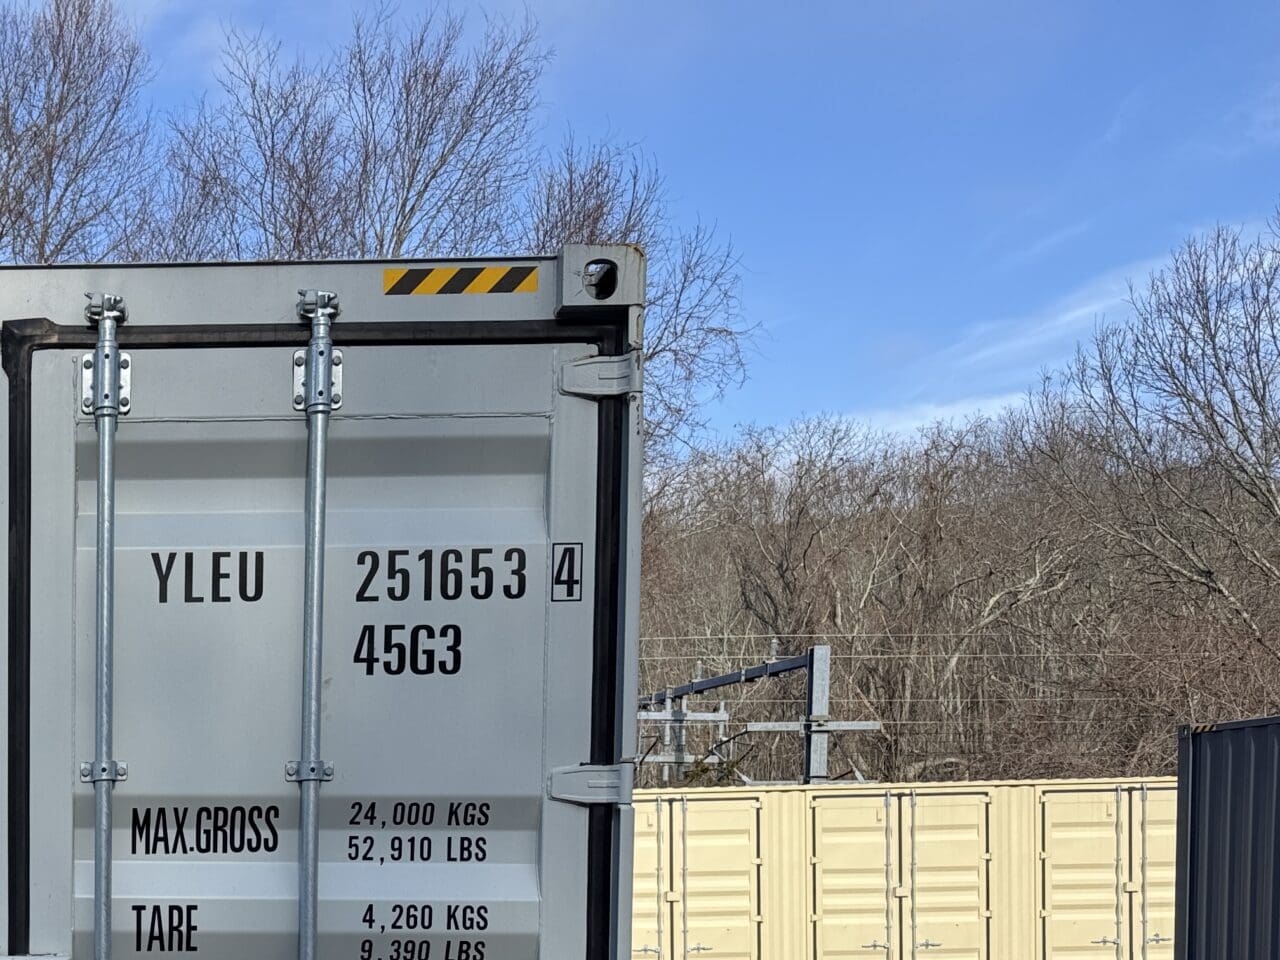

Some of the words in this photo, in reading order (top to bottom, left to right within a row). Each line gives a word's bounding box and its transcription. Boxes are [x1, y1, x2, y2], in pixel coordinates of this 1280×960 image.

[150, 551, 264, 603] YLEU
[355, 547, 527, 602] 251653
[555, 547, 580, 597] 4
[353, 624, 462, 675] 45G3
[131, 805, 280, 855] MAX.GROSS
[348, 802, 436, 829] 24,000
[447, 802, 491, 827] KGS
[347, 836, 432, 865] 52,910
[447, 837, 487, 862] LBS
[131, 904, 199, 952] TARE
[362, 904, 433, 934] 4,260
[446, 905, 489, 930] KGS
